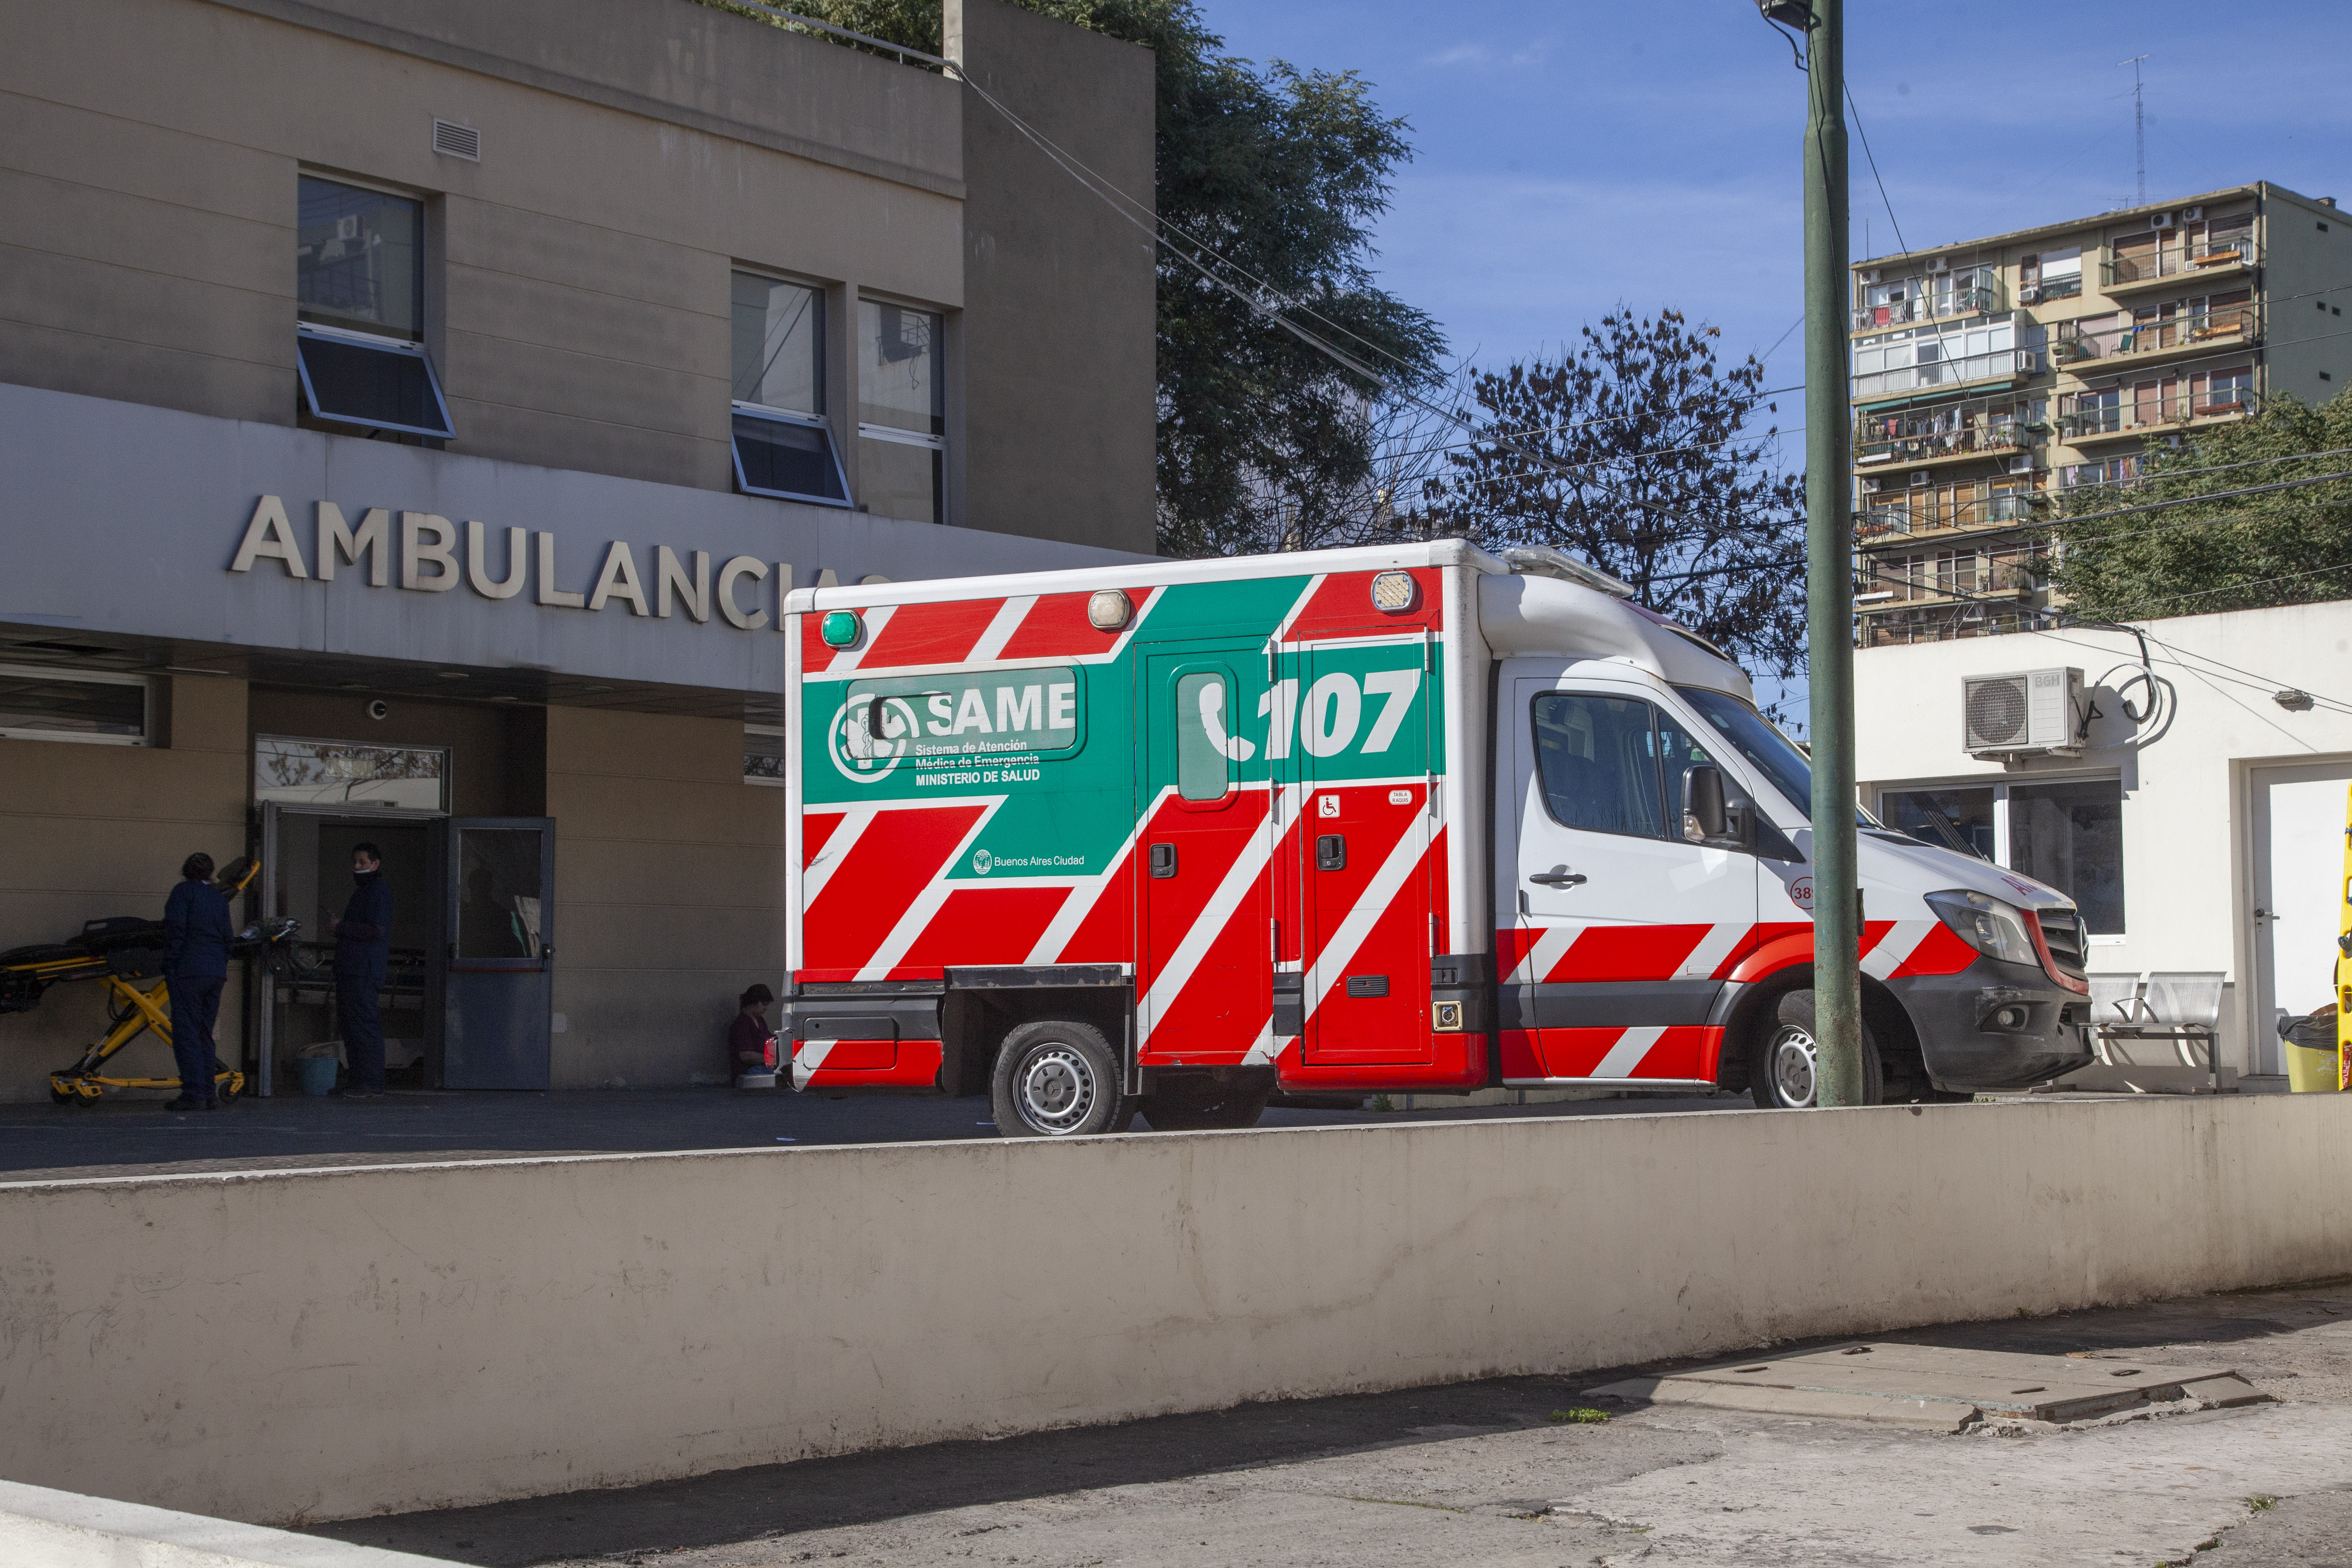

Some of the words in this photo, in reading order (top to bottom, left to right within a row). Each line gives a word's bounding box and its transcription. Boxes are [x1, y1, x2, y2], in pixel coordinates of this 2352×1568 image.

[227, 494, 893, 631] AMBULANCI
[2035, 674, 2060, 688] BGH
[922, 683, 1075, 736] SAME
[1258, 668, 1421, 760] 107
[915, 743, 959, 756] Sistema
[962, 742, 976, 753] de
[978, 739, 1027, 752] Atención
[916, 757, 956, 770] Médica
[958, 756, 972, 768] de
[974, 753, 1040, 768] Emergencia
[916, 772, 980, 786] MINISTERIO
[983, 771, 998, 783] DE
[1001, 769, 1040, 782] SALUD
[994, 856, 1028, 866] Buenos
[1030, 856, 1052, 866] Aires
[1054, 855, 1085, 866] Ciudad
[1794, 887, 1813, 899] 38
